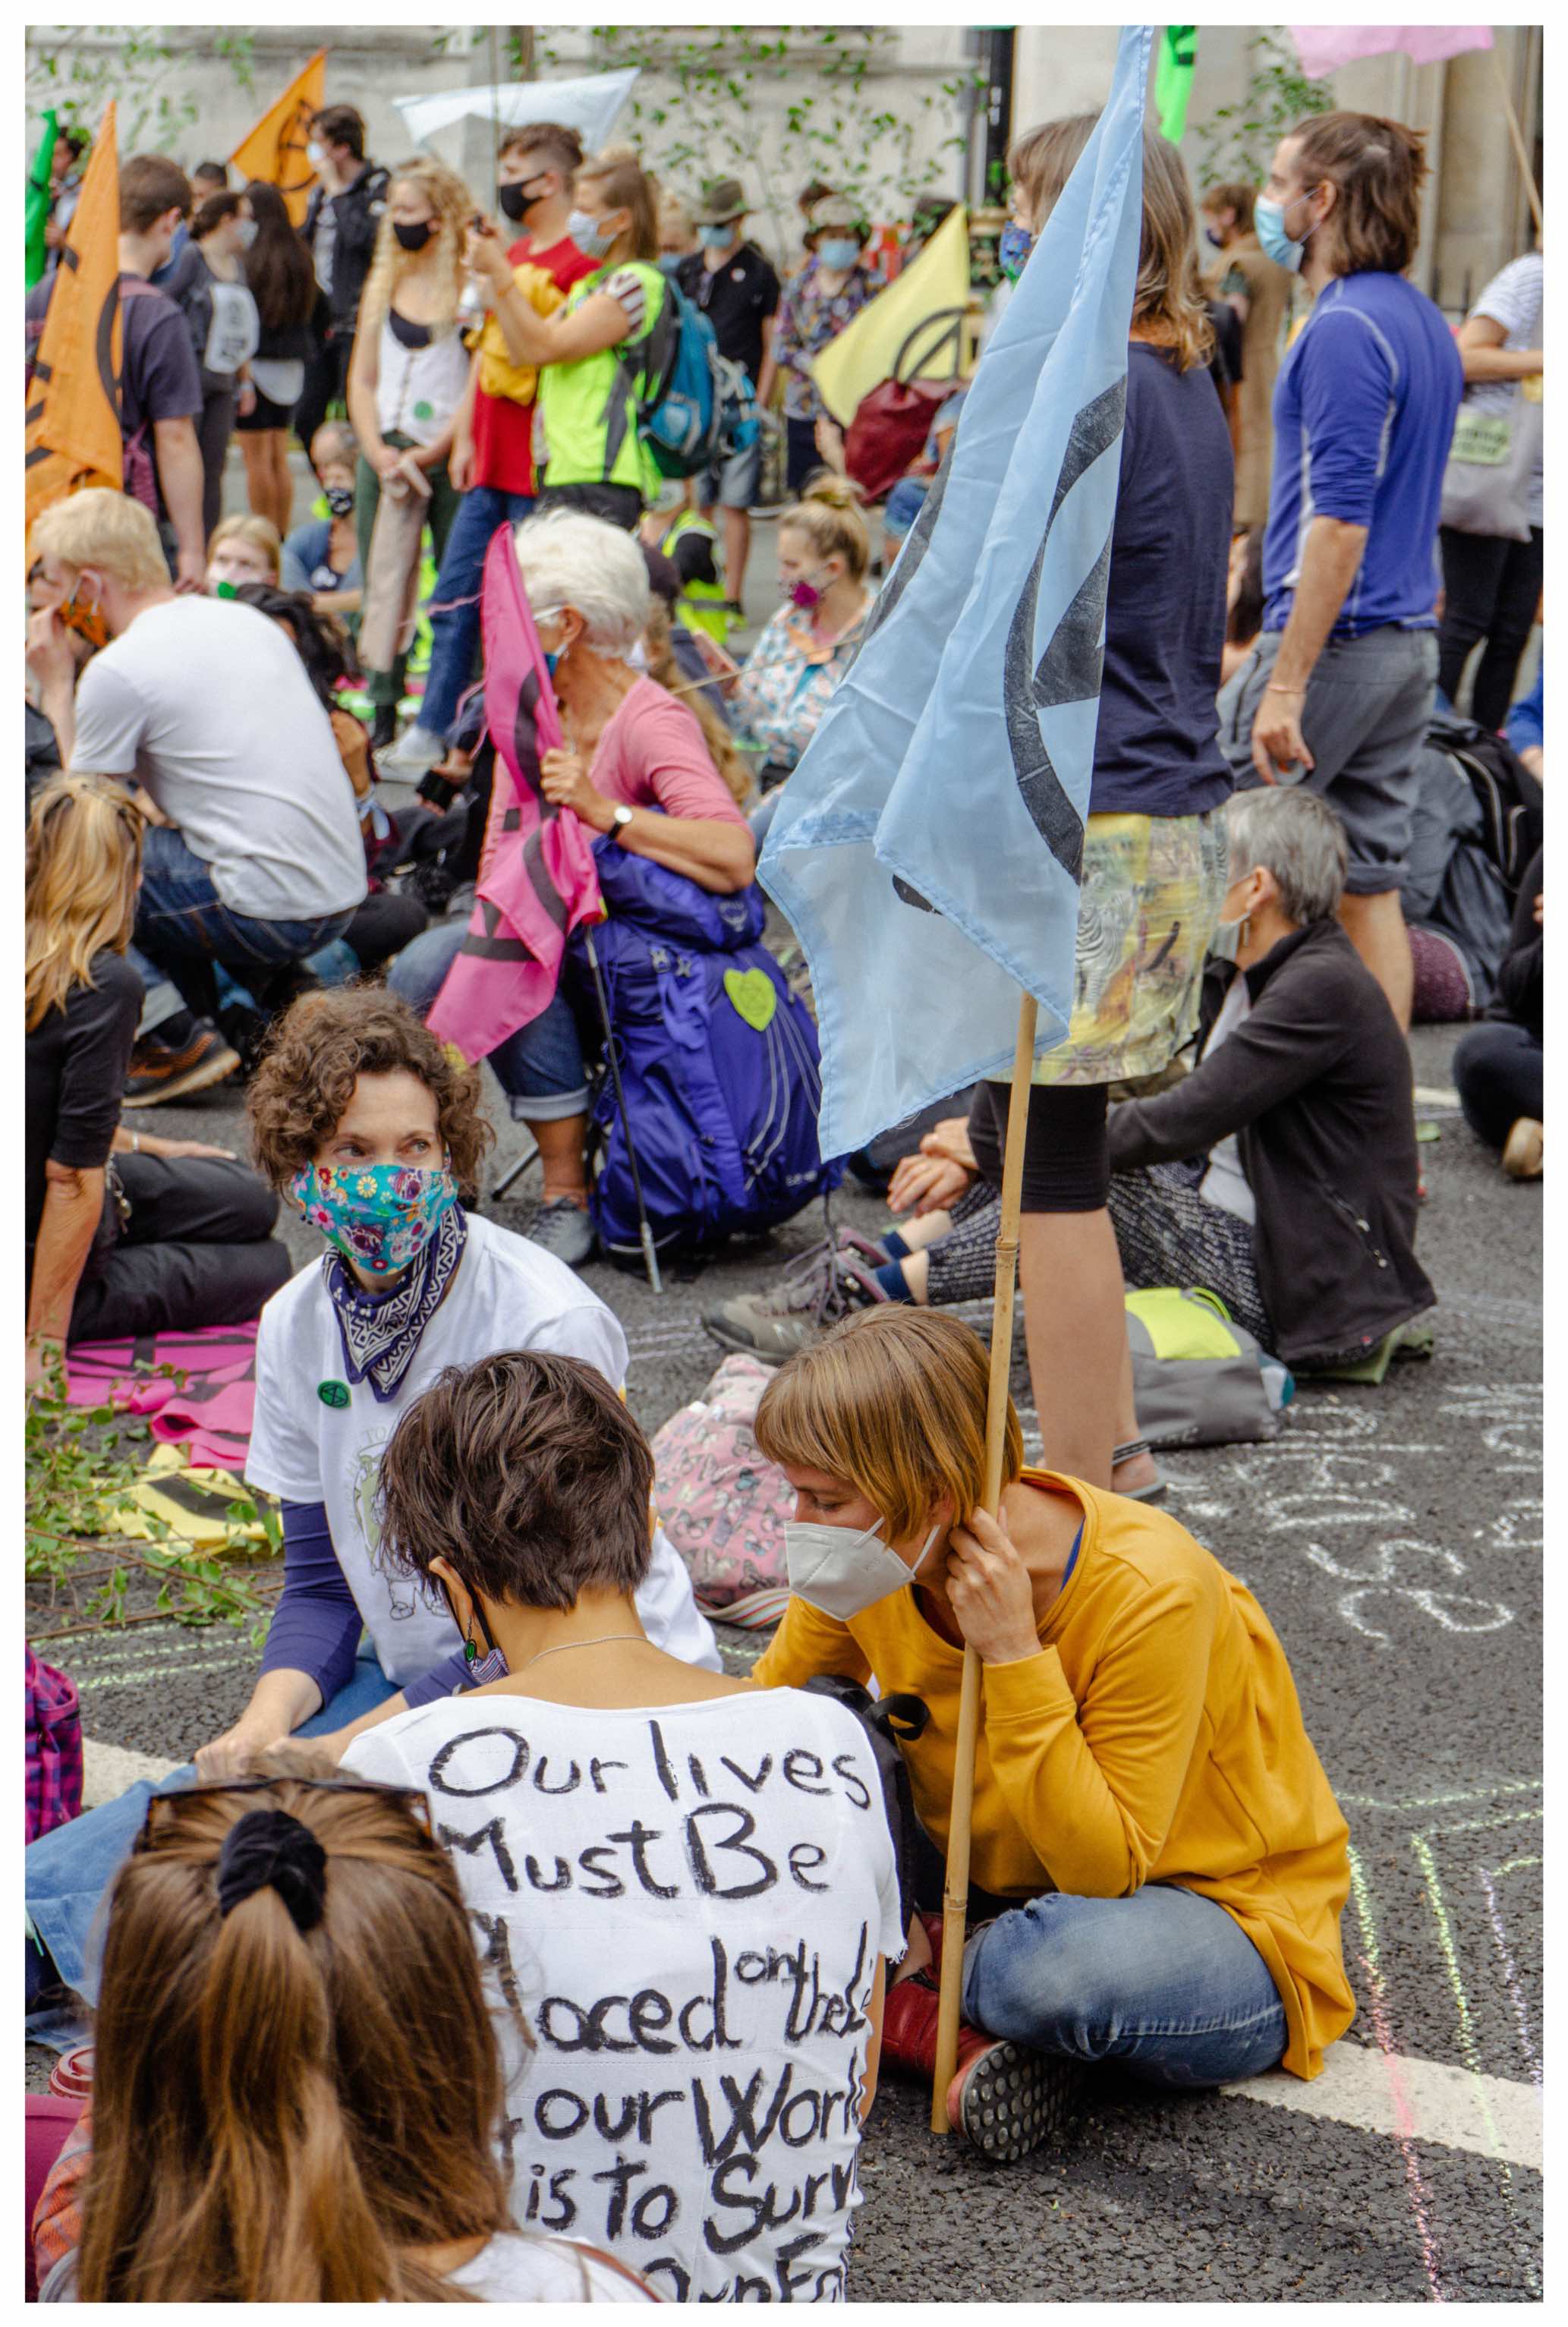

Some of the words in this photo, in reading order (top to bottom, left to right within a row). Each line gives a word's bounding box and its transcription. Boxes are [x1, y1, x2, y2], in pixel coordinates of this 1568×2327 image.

[428, 1725, 629, 1798] Our
[649, 1719, 871, 1810] lives
[437, 1816, 679, 1899] Must
[680, 1801, 827, 1900] Be
[471, 1912, 742, 2051] laced
[534, 2088, 685, 2146] our
[525, 2164, 578, 2231] is
[703, 2153, 858, 2255] Surv
